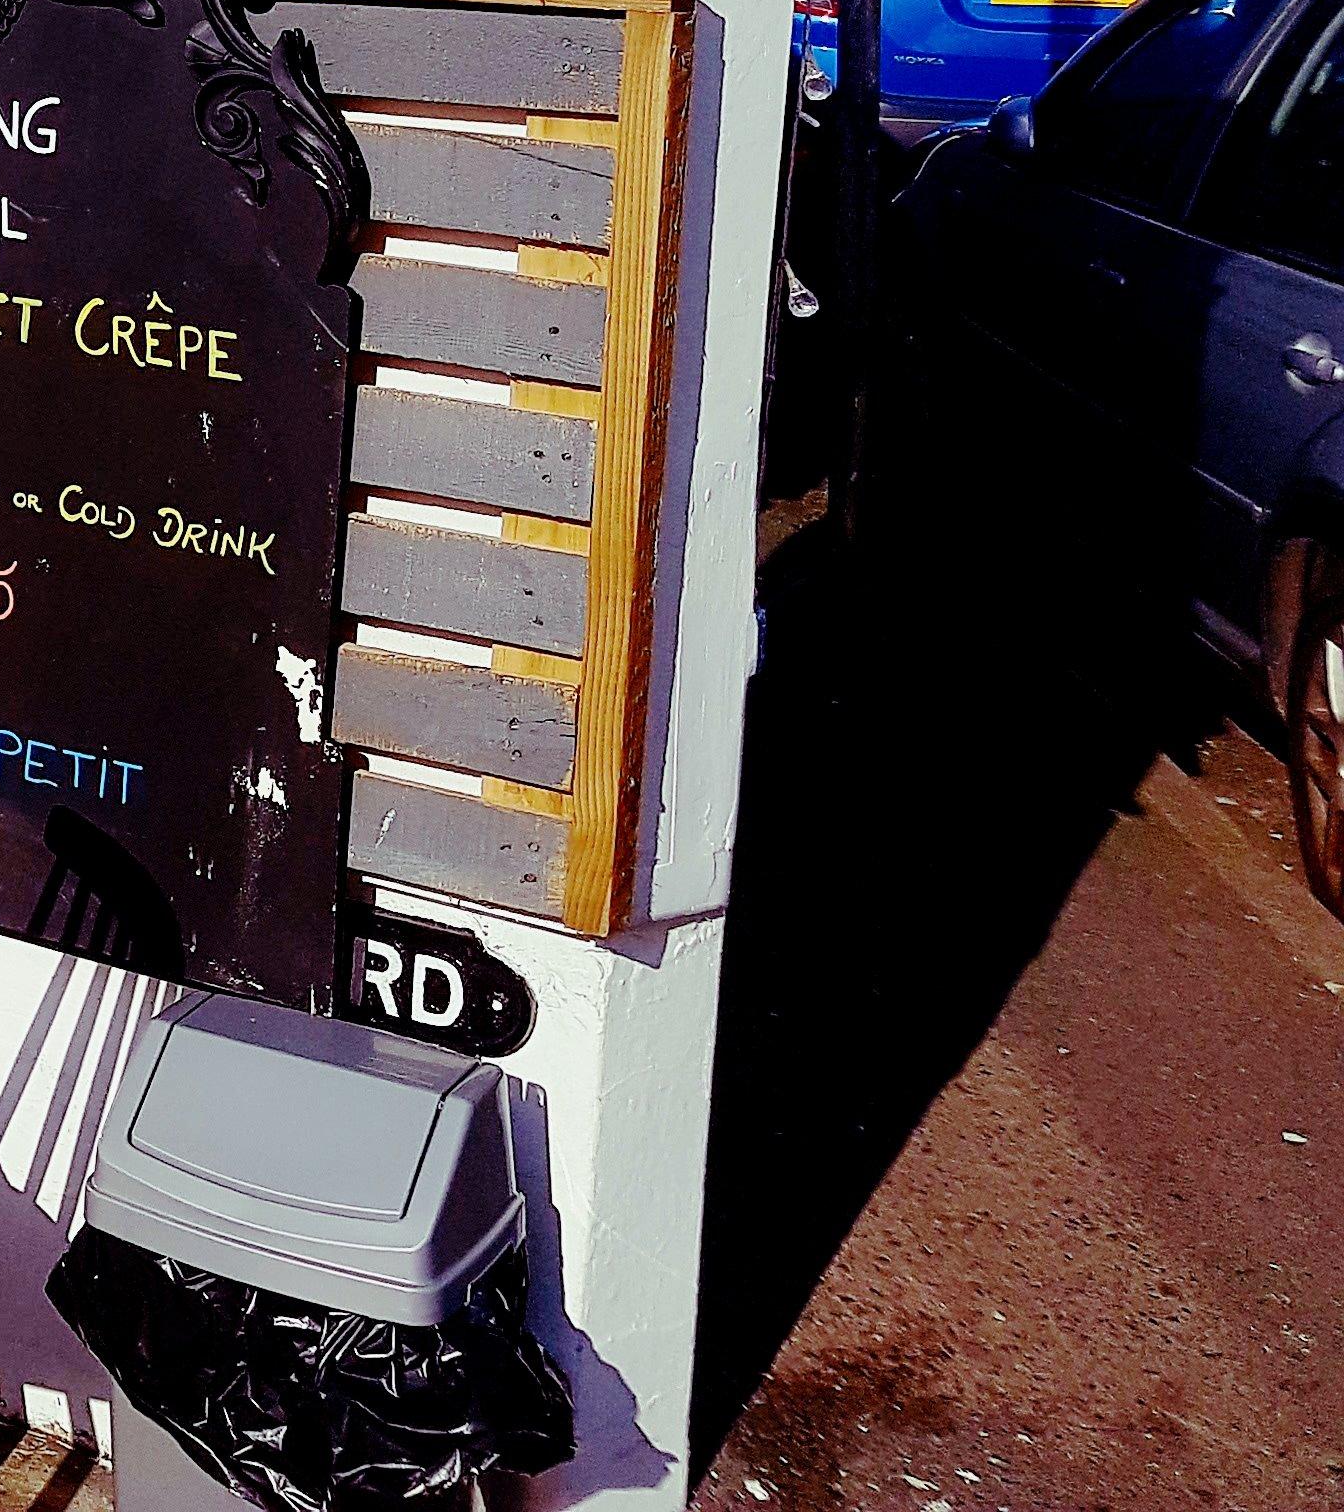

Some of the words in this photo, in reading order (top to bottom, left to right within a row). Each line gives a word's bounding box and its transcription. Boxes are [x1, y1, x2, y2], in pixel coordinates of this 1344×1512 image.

[75, 291, 242, 381] CRÊPE
[13, 493, 42, 512] OR
[59, 485, 135, 538] COLD
[153, 508, 275, 574] DRINK
[351, 937, 465, 1027] RD
